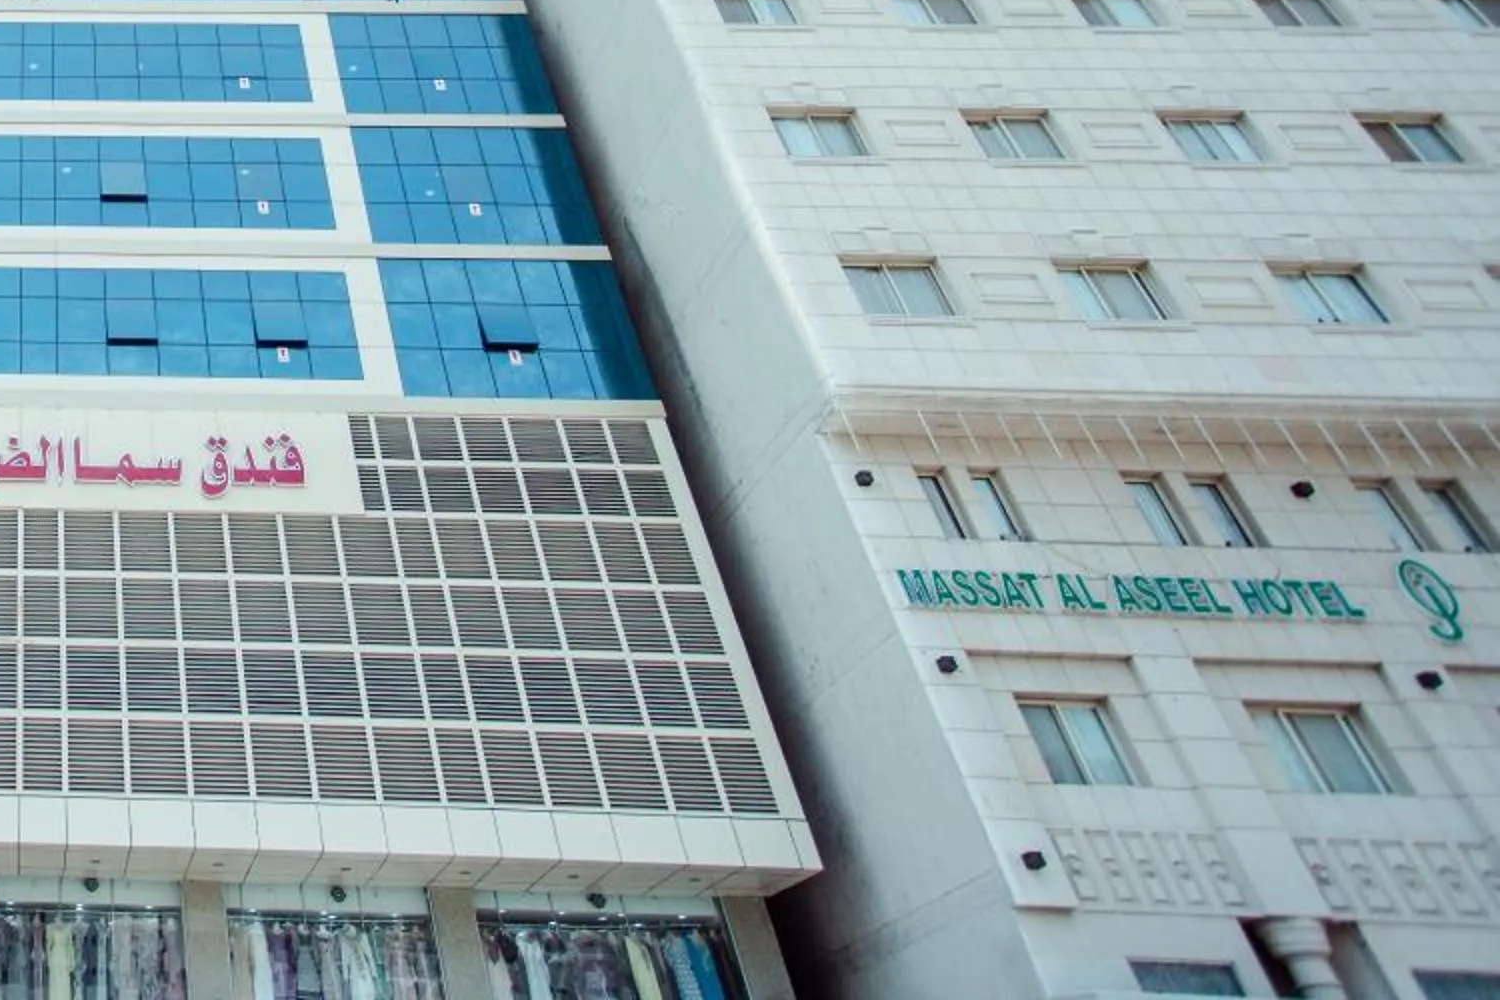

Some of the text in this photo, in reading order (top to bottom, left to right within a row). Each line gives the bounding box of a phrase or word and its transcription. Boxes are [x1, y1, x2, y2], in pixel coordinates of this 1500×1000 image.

[72, 435, 185, 485] سما
[199, 433, 307, 498] فندق
[898, 569, 1364, 618] MASSAT AL ASEEL HOTEL
